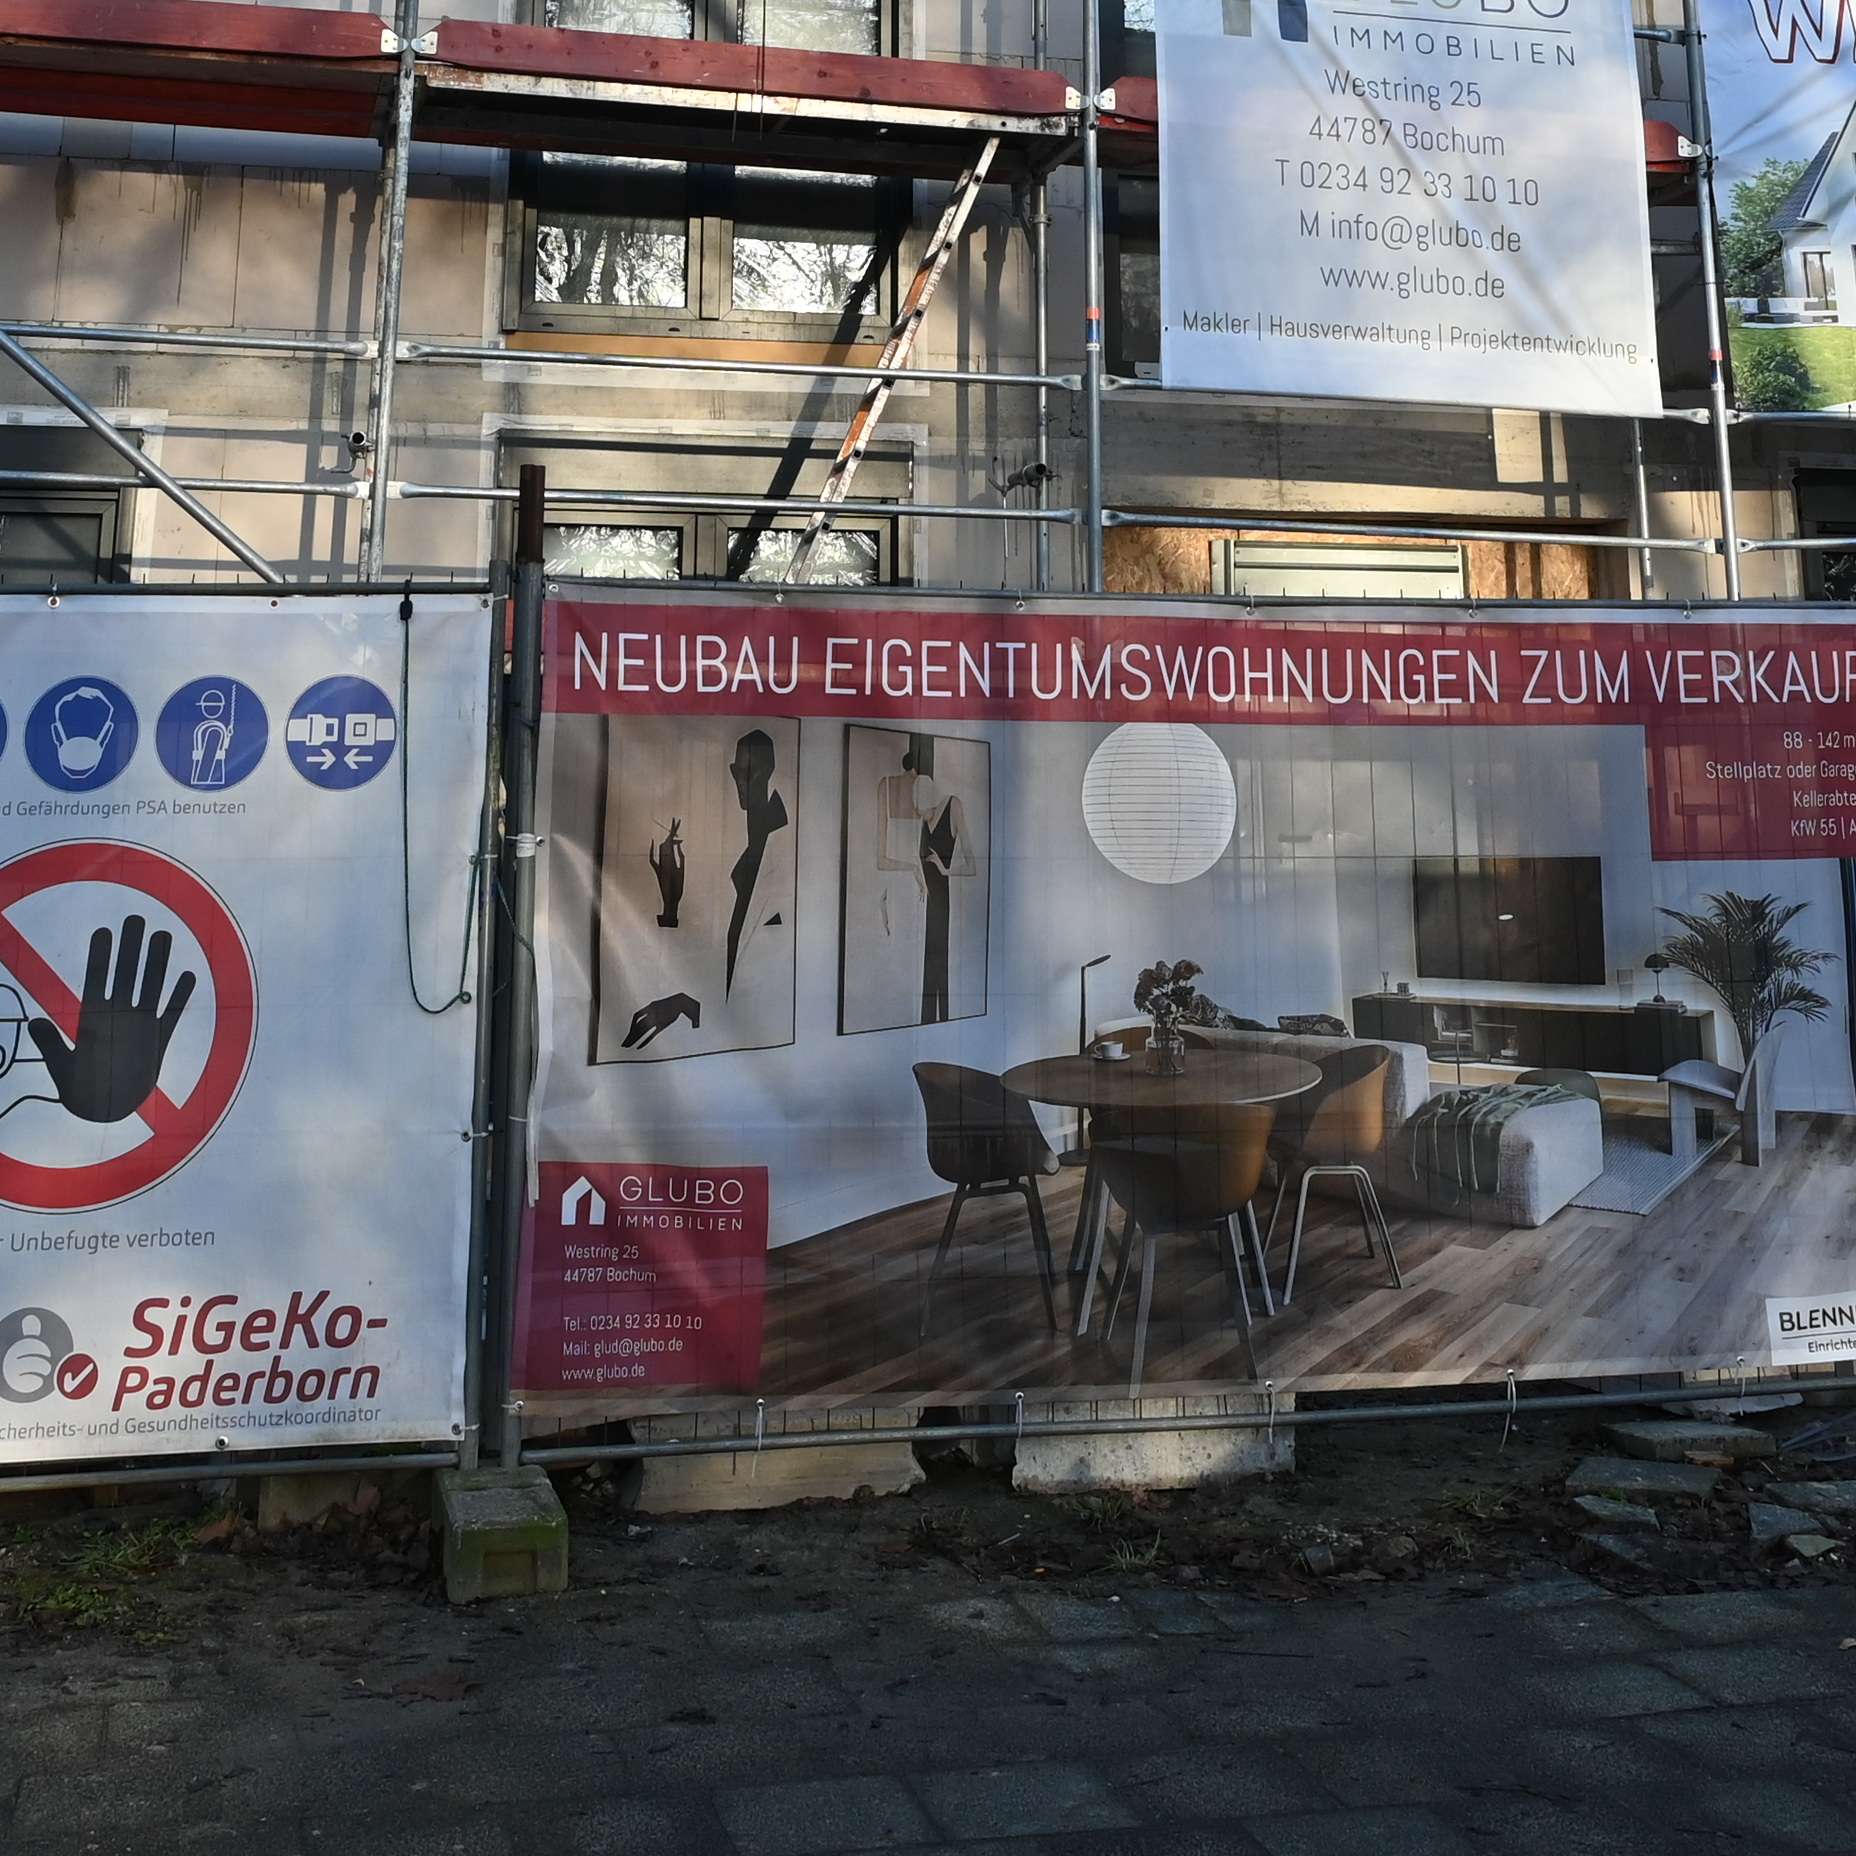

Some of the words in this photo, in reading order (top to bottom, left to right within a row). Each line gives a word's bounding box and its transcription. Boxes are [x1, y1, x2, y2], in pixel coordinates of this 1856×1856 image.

[1333, 25, 1575, 68] IMMOBILIEN
[1324, 69, 1442, 111] Westring
[1450, 81, 1482, 109] 25
[1309, 116, 1393, 146] 44787
[1404, 123, 1505, 157] Bochum
[1275, 159, 1291, 188] T
[1299, 161, 1368, 192] 0234
[1380, 167, 1412, 196] 92
[1424, 171, 1453, 200] 33
[1464, 175, 1497, 203] 10
[1507, 178, 1540, 206] 10
[1299, 210, 1320, 239] M
[1331, 212, 1522, 254] info@glubo.de
[1320, 266, 1505, 300] www.glubo.de
[1182, 310, 1250, 336] Makler
[1269, 316, 1431, 352] Hausverwaltung
[1450, 326, 1638, 365] Projektentwicklung
[574, 631, 799, 694] NEUBAU
[824, 637, 1499, 706] EIGENTUMSWOHNUNGEN
[1521, 649, 1630, 705] ZUM
[1783, 731, 1803, 749] 88
[1818, 731, 1840, 749] 142
[1706, 760, 1782, 783] Stellplatz
[1786, 762, 1816, 779] oder
[16, 800, 131, 820] Gefährdungen
[136, 800, 169, 816] PSA
[172, 799, 247, 816] benutzen
[1791, 820, 1817, 837] KfW
[1820, 818, 1837, 836] 55
[619, 1174, 744, 1206] GLUBO
[617, 1214, 743, 1231] IMMOBILIEN
[10, 1229, 120, 1255] Unbefugte
[126, 1227, 215, 1249] verboten
[564, 1244, 619, 1261] Westring
[623, 1244, 639, 1259] 25
[564, 1267, 603, 1283] 44787
[607, 1267, 657, 1284] Bochum
[122, 1289, 388, 1359] SiGeKo-
[590, 1315, 621, 1331] 0234
[625, 1314, 641, 1329] 92
[644, 1314, 660, 1329] 33
[665, 1314, 682, 1329] 10
[686, 1316, 703, 1330] 10
[563, 1341, 591, 1356] Mail:
[593, 1337, 684, 1358] glud@glubo.de
[111, 1355, 381, 1412] Paderborn
[562, 1363, 646, 1382] www.glubo.de
[87, 1418, 119, 1436] und
[124, 1407, 382, 1435] Gesundheitsschutzkoordinator
